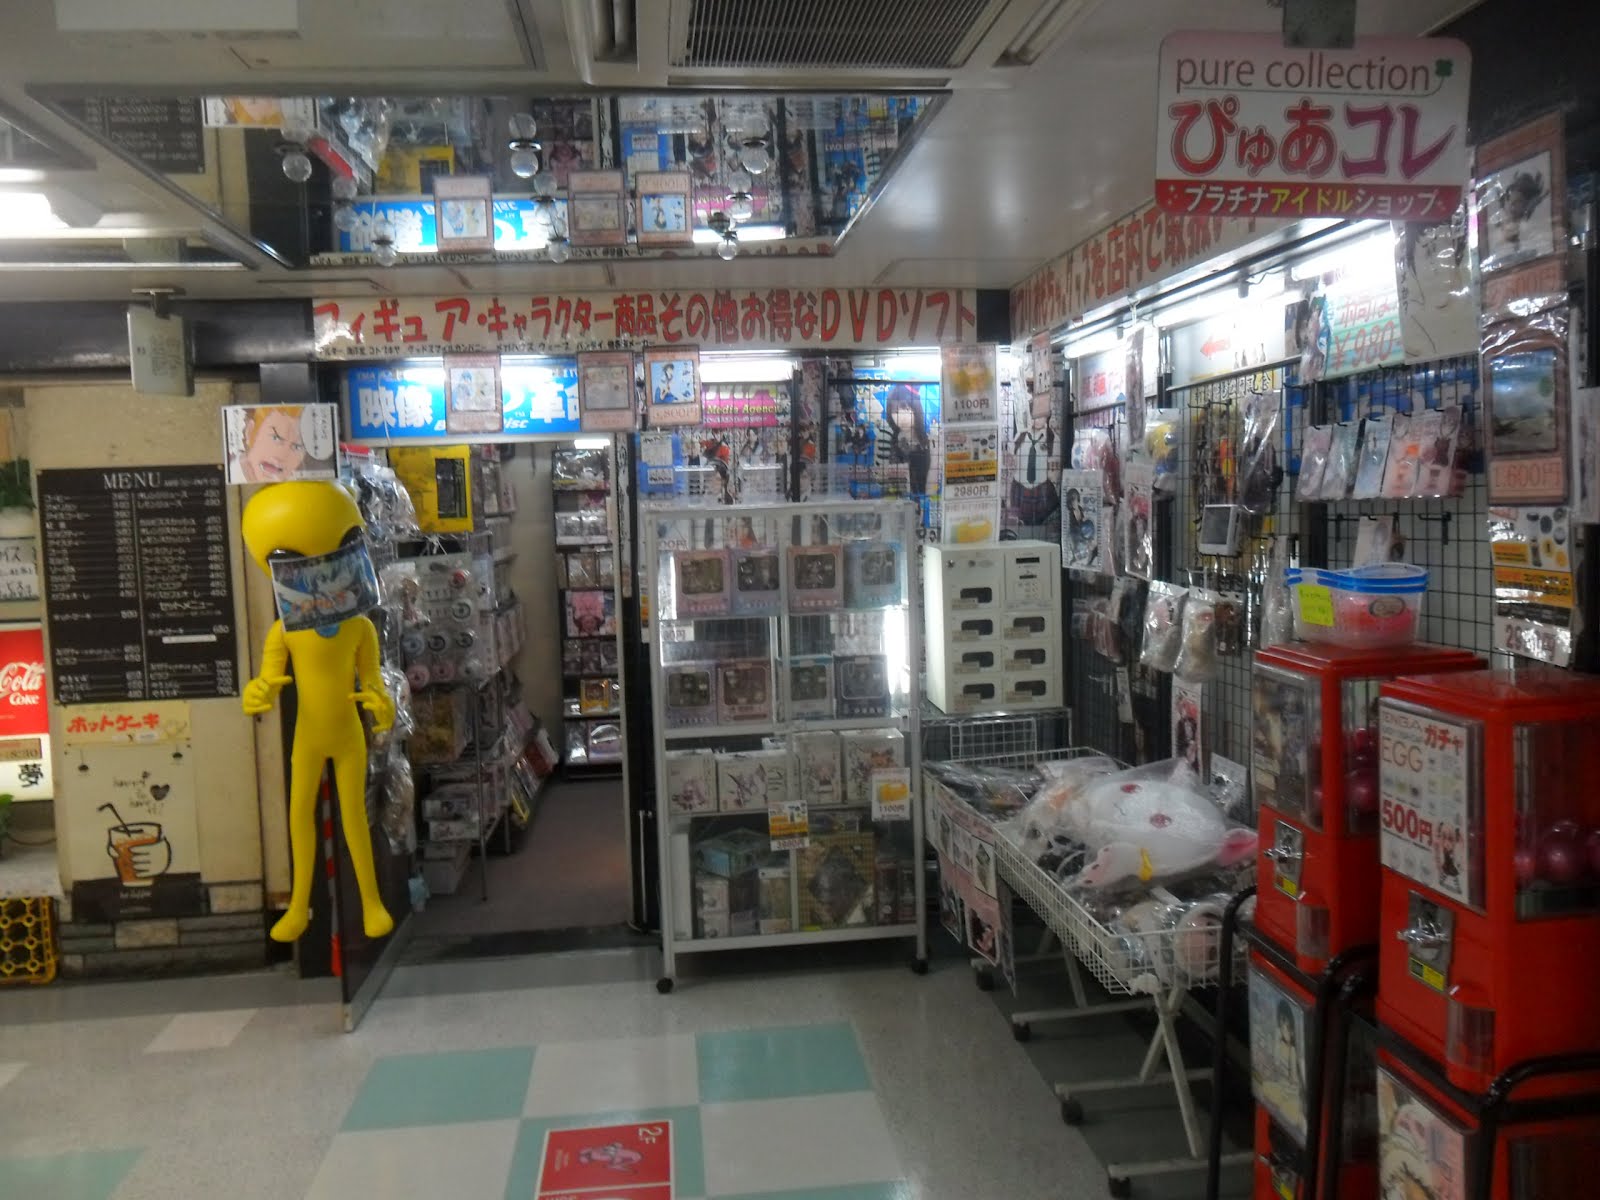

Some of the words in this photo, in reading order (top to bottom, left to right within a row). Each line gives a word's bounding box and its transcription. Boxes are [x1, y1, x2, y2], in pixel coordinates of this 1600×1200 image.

[1176, 57, 1254, 93] pure
[1266, 52, 1430, 92] collection
[1168, 95, 1457, 179] ぴゅあコレ
[1185, 184, 1438, 217] プラチナアイドルショップ
[359, 385, 433, 428] 映像
[103, 472, 160, 490] MENU
[9, 692, 40, 706] Coke
[67, 712, 160, 733] ホットケーキ
[1382, 735, 1423, 774] EGG
[1382, 799, 1433, 846] 500円
